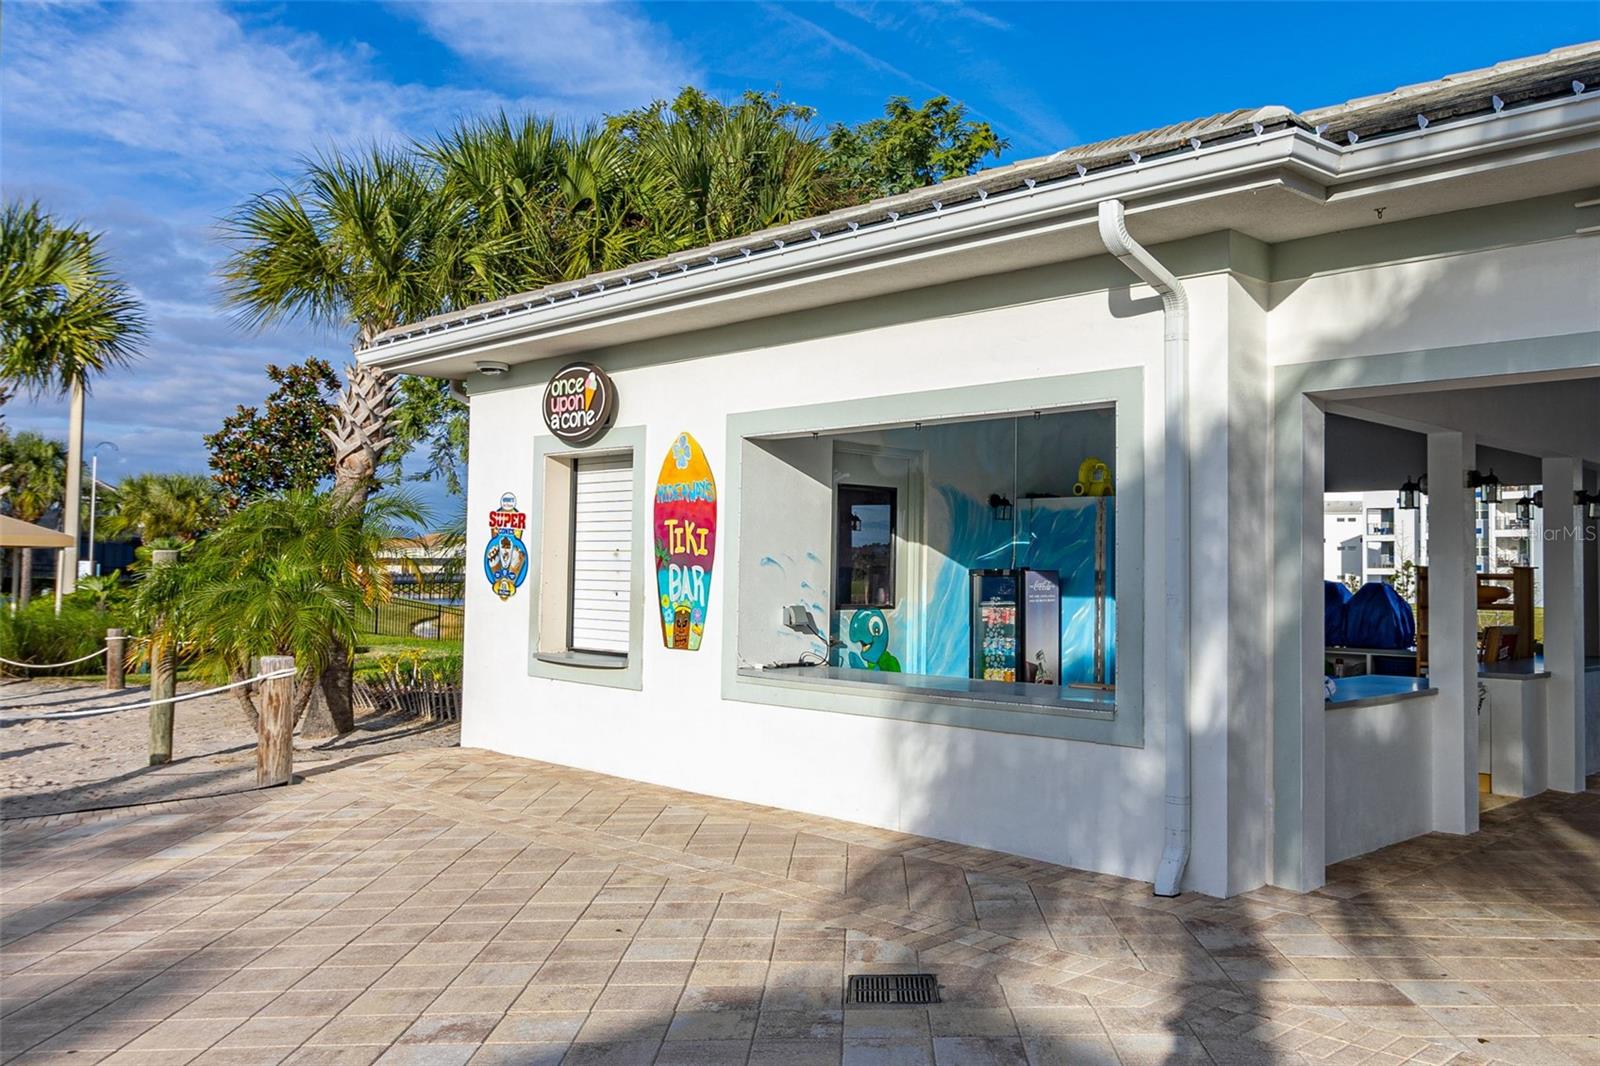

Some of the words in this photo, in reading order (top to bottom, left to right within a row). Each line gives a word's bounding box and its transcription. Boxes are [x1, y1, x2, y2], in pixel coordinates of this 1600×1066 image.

[551, 377, 585, 396] once
[551, 393, 585, 417] upon
[550, 413, 560, 430] a
[561, 409, 596, 429] cone
[488, 510, 527, 530] SUPER
[663, 518, 709, 556] TIKI
[669, 563, 706, 607] BAR
